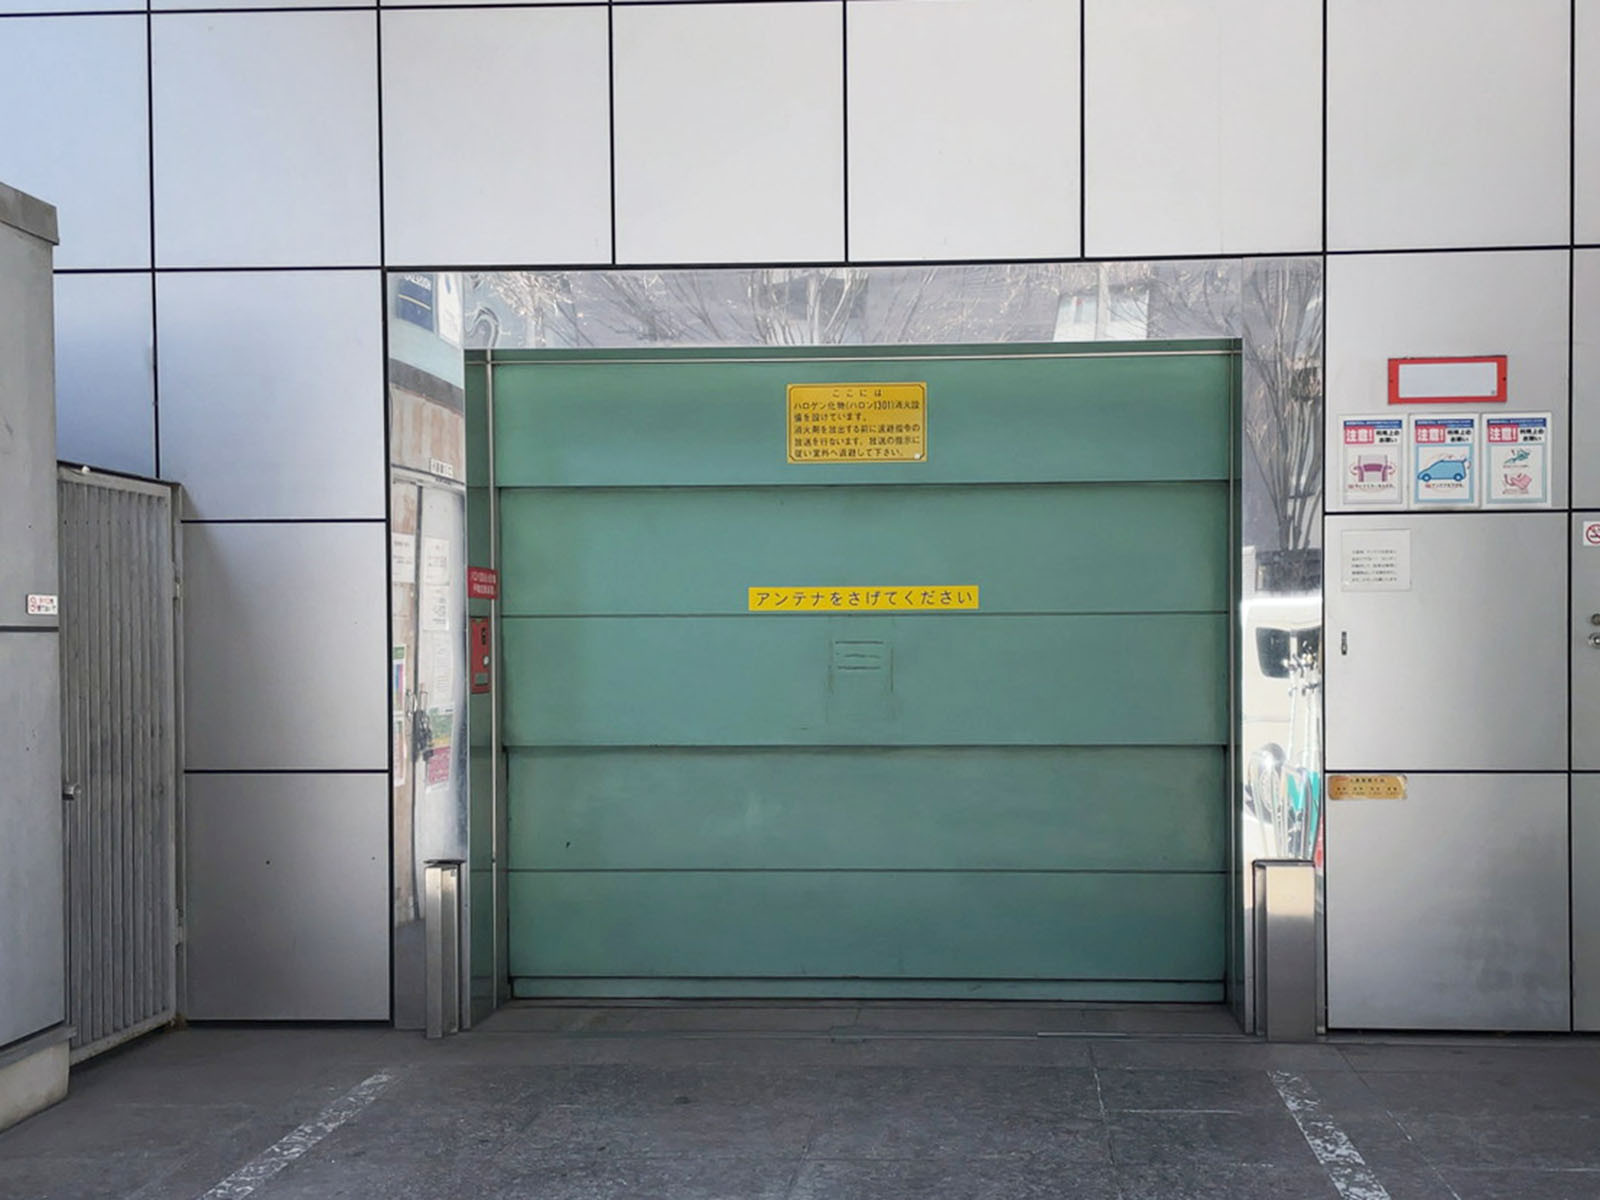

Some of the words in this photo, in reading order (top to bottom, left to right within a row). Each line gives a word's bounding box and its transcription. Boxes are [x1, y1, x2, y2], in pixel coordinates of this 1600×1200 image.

[756, 590, 973, 607] アンテナをさげてください
